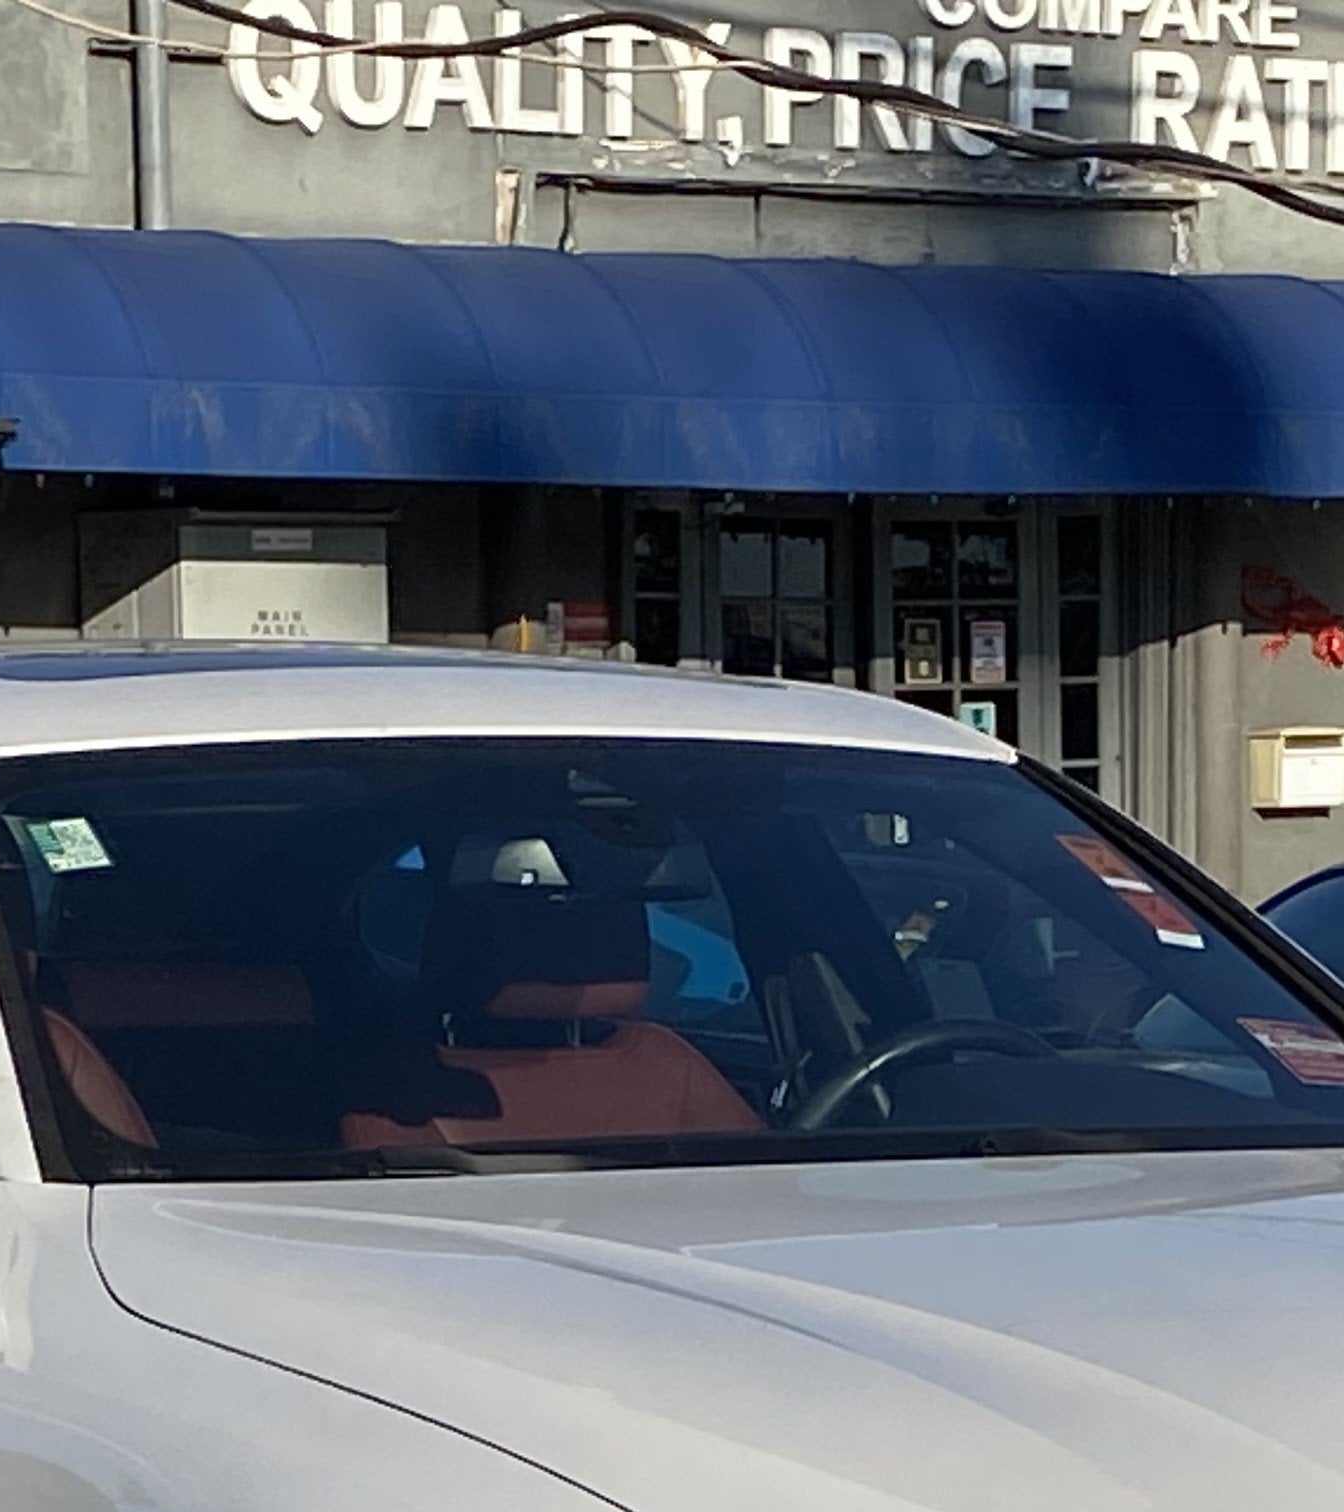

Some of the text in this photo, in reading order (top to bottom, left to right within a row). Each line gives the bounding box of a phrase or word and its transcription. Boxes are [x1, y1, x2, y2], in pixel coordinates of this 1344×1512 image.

[763, 27, 1074, 157] PRICE
[257, 610, 303, 621] MAIN
[250, 622, 309, 637] PANEL
